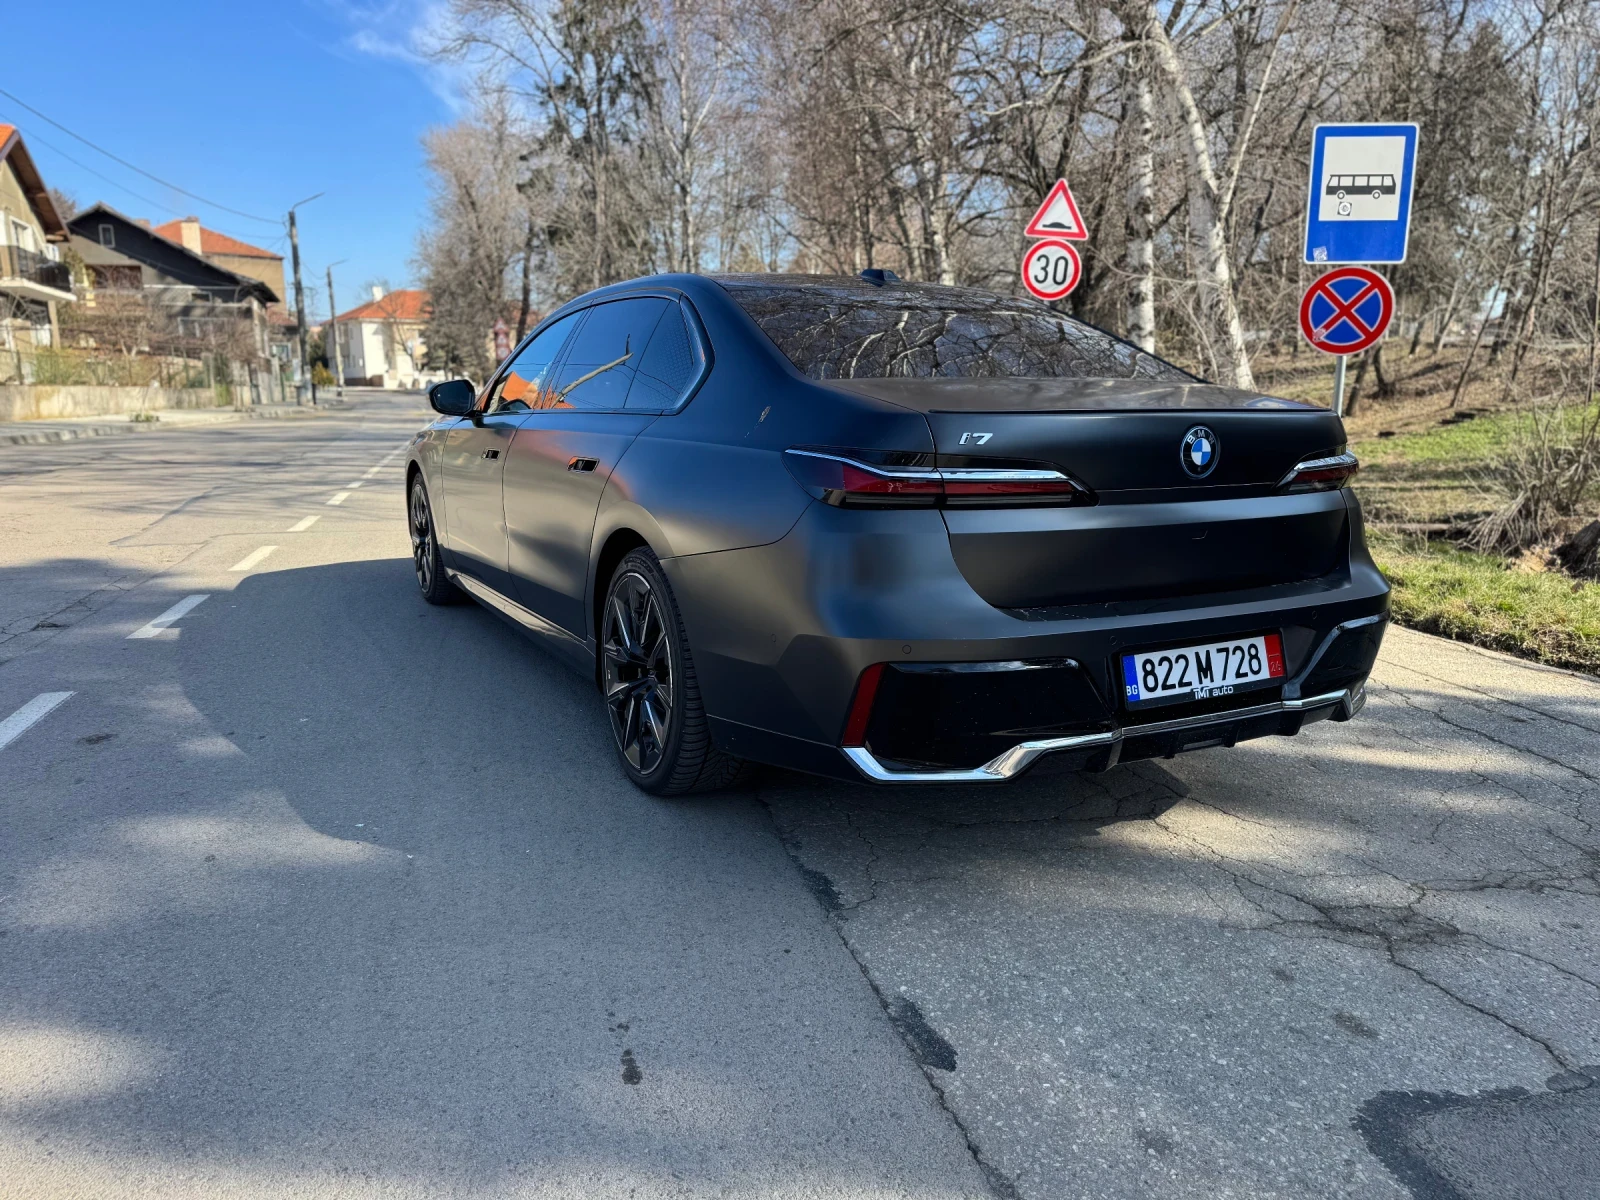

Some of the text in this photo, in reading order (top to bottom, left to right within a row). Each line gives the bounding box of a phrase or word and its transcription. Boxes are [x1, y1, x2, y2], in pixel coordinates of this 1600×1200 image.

[1034, 254, 1069, 286] 30
[958, 432, 994, 445] i7
[1187, 429, 1215, 445] BMW
[1126, 684, 1138, 696] BG
[1213, 685, 1234, 697] auto
